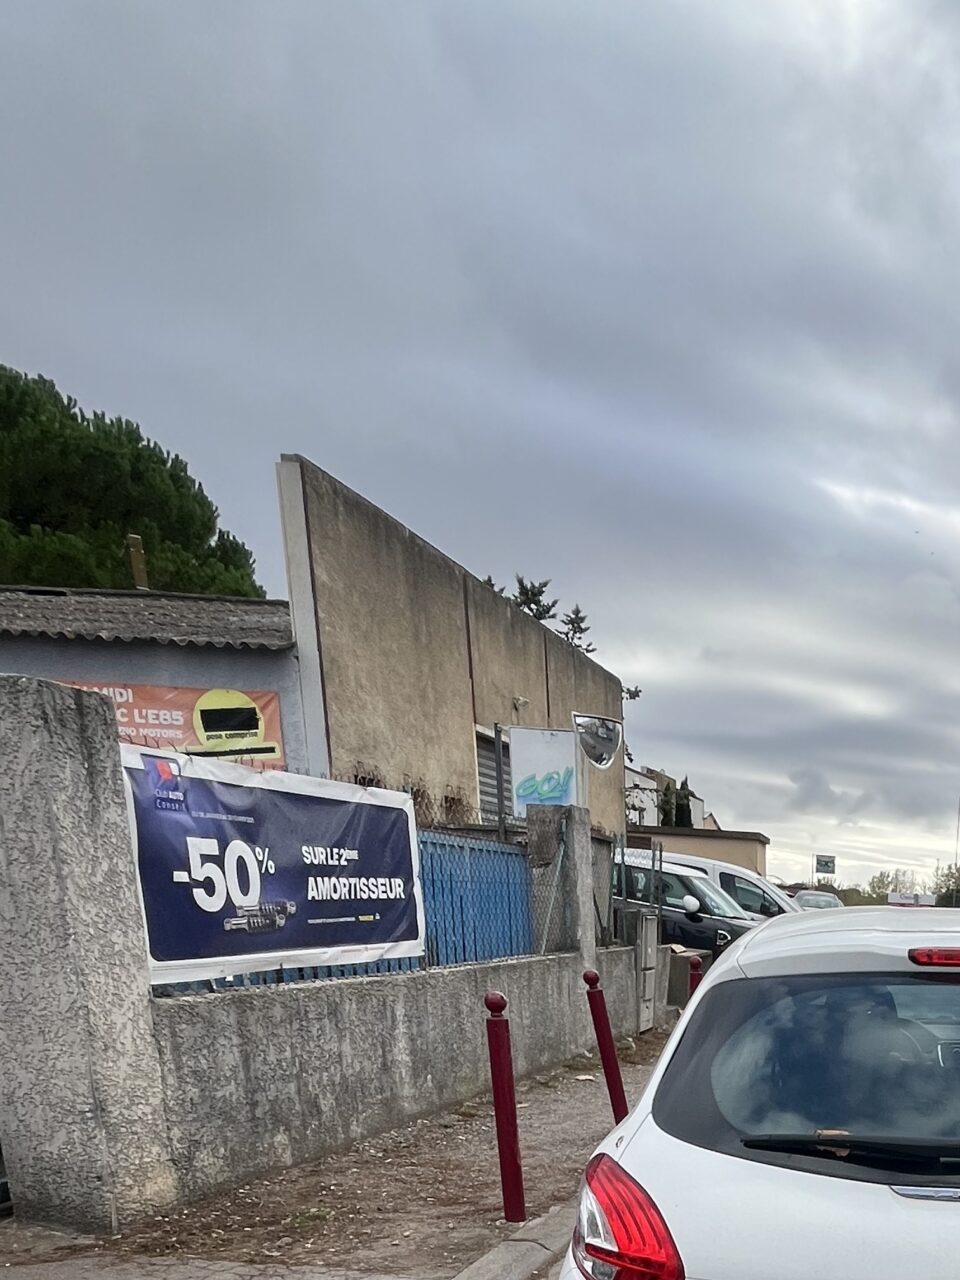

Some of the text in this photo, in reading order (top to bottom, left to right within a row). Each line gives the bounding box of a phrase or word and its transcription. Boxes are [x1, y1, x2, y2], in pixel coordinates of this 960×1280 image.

[133, 708, 185, 725] L'E85
[139, 727, 183, 739] MOTORS
[301, 845, 327, 865] SUR
[326, 847, 339, 865] LE
[307, 877, 405, 901] AMORTISSEUR
